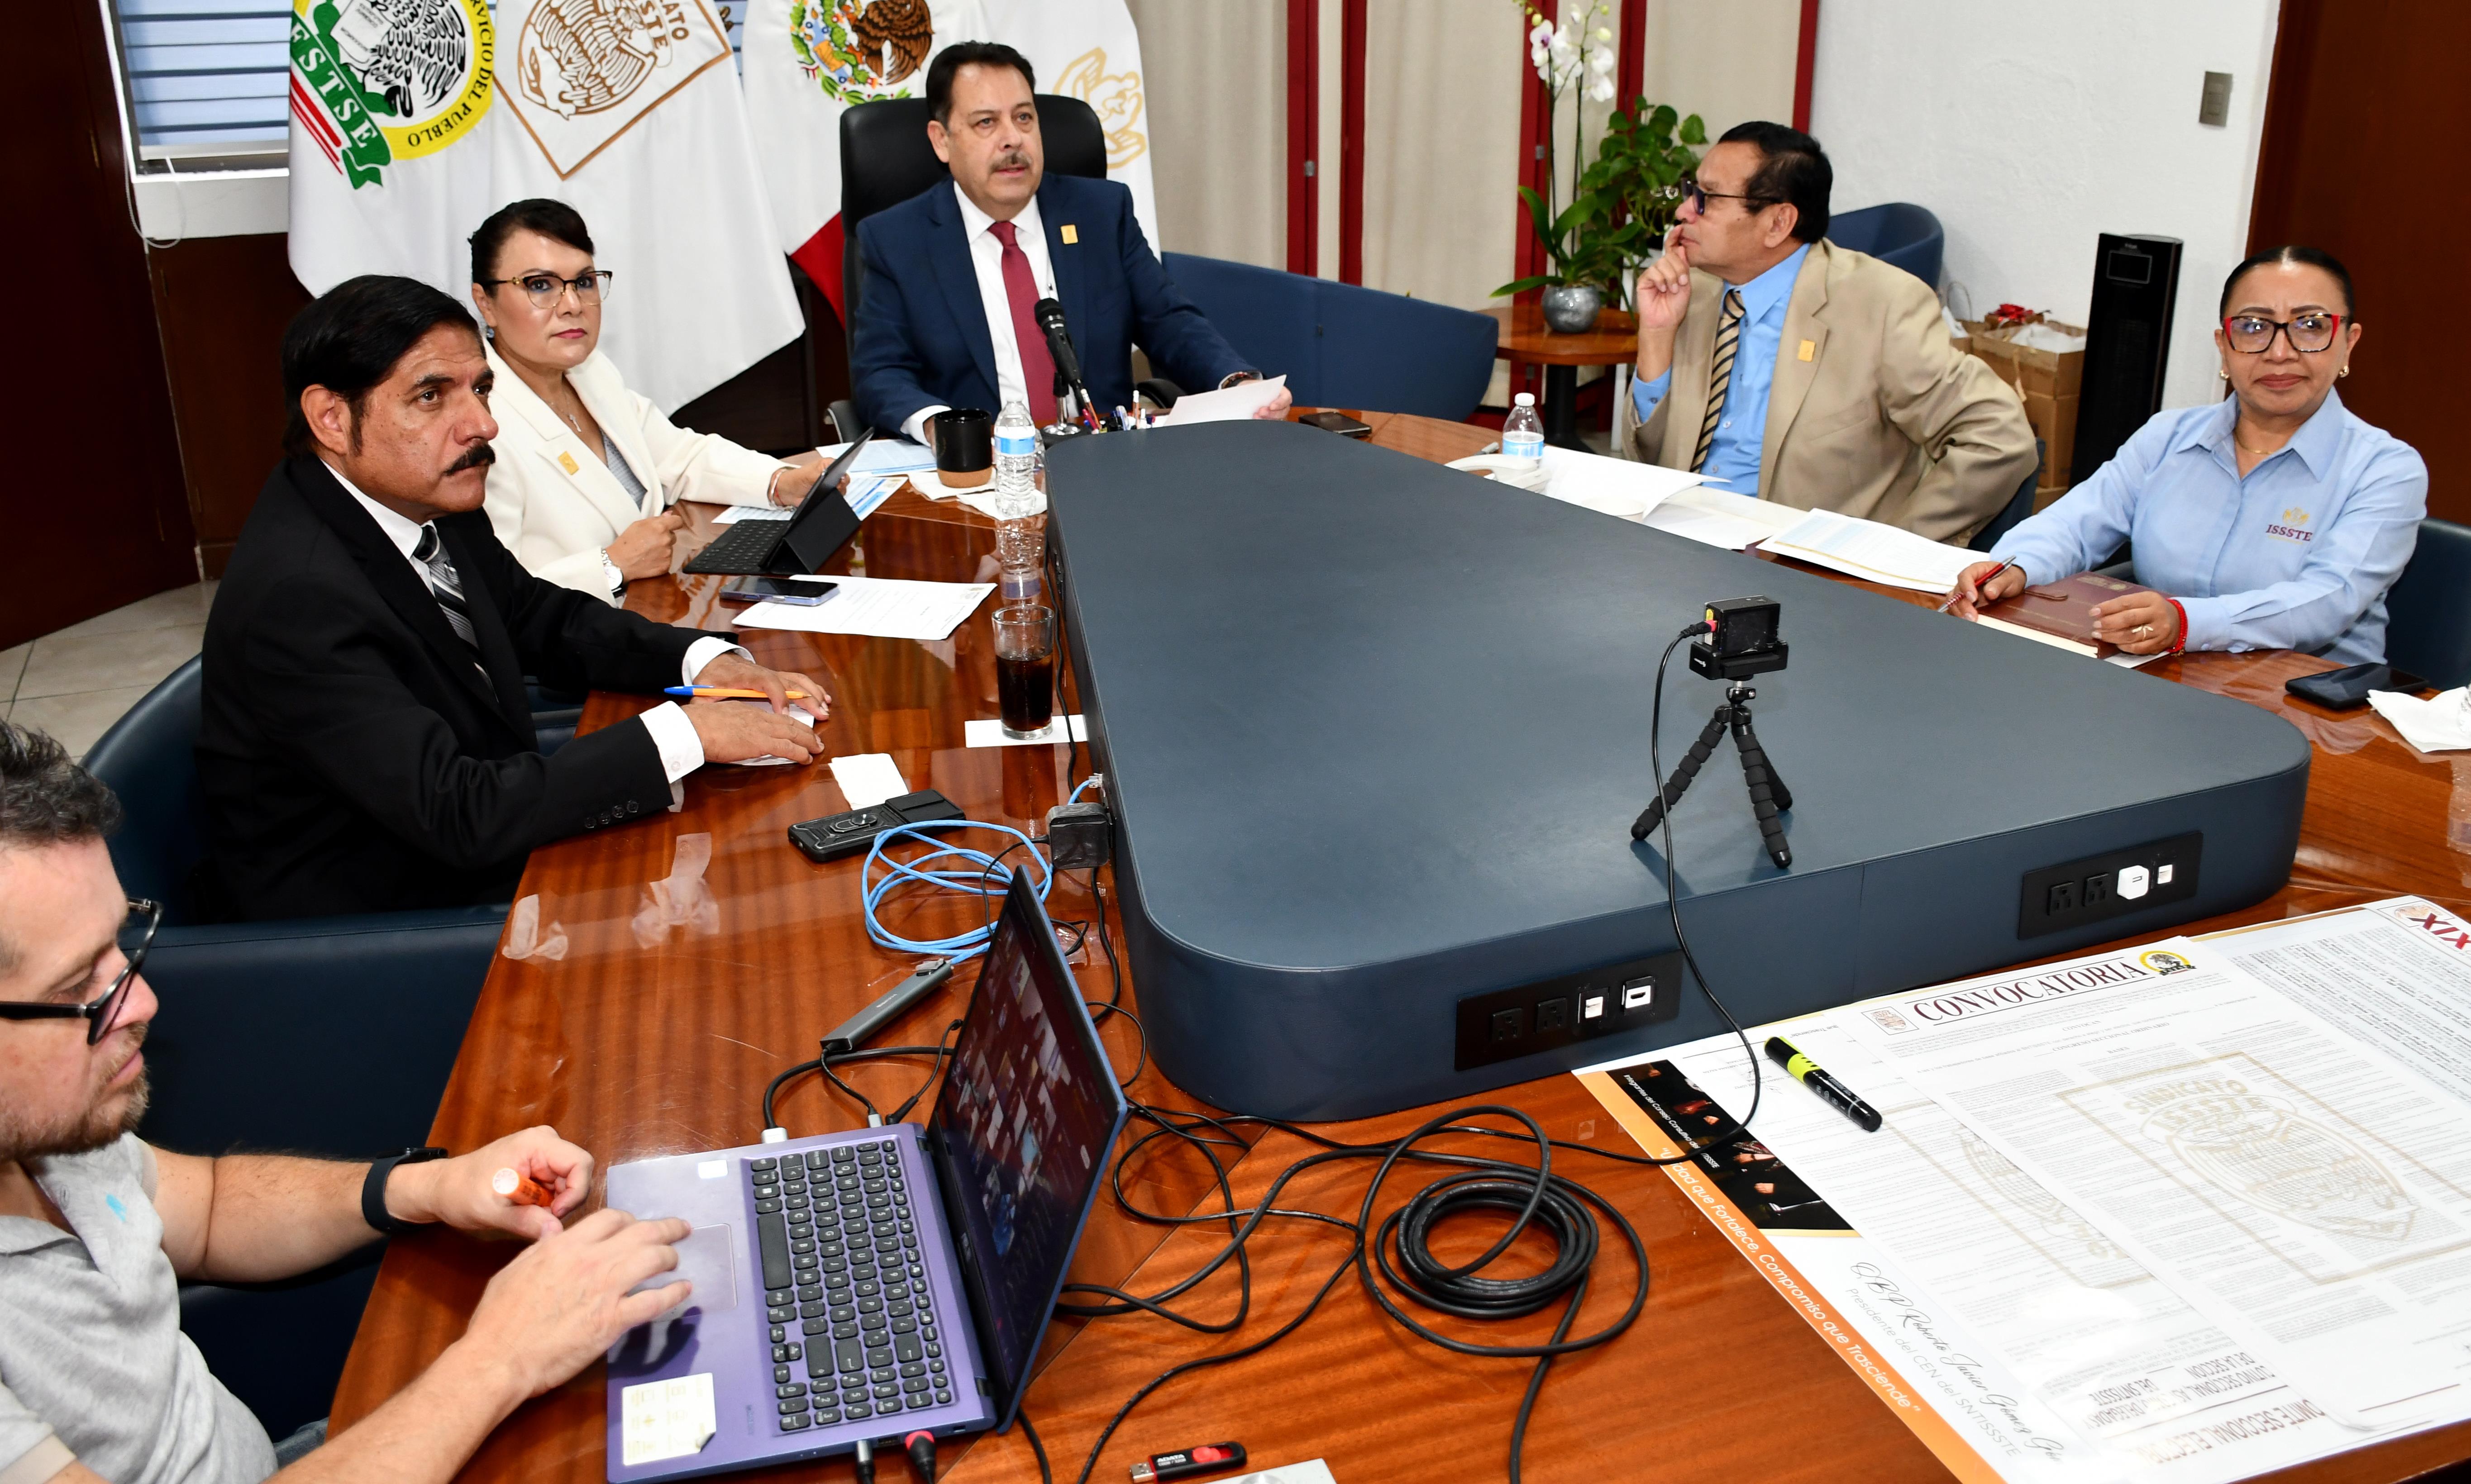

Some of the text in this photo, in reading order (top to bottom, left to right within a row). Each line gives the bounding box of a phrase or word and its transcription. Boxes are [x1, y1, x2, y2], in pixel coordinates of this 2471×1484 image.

[408, 0, 494, 147] RVICIO DEL PUEBLO
[2265, 523, 2313, 542] ISSSTE
[1913, 960, 2150, 1021] CONVOCATORIA
[2123, 1079, 2249, 1117] SINDICATO
[1692, 1185, 1715, 1204] que
[1711, 1204, 1759, 1253] Fortalece,
[1759, 1254, 1826, 1320] Compromiso
[1823, 1321, 1850, 1344] que
[1846, 1288, 2022, 1457] Presidente del CEN del SNTISSSTE
[1896, 1308, 1952, 1352] Roberto
[1939, 1353, 1989, 1391] Javier
[2200, 1410, 2285, 1445] SECCIONAL
[1157, 1454, 1185, 1463] ADATA
